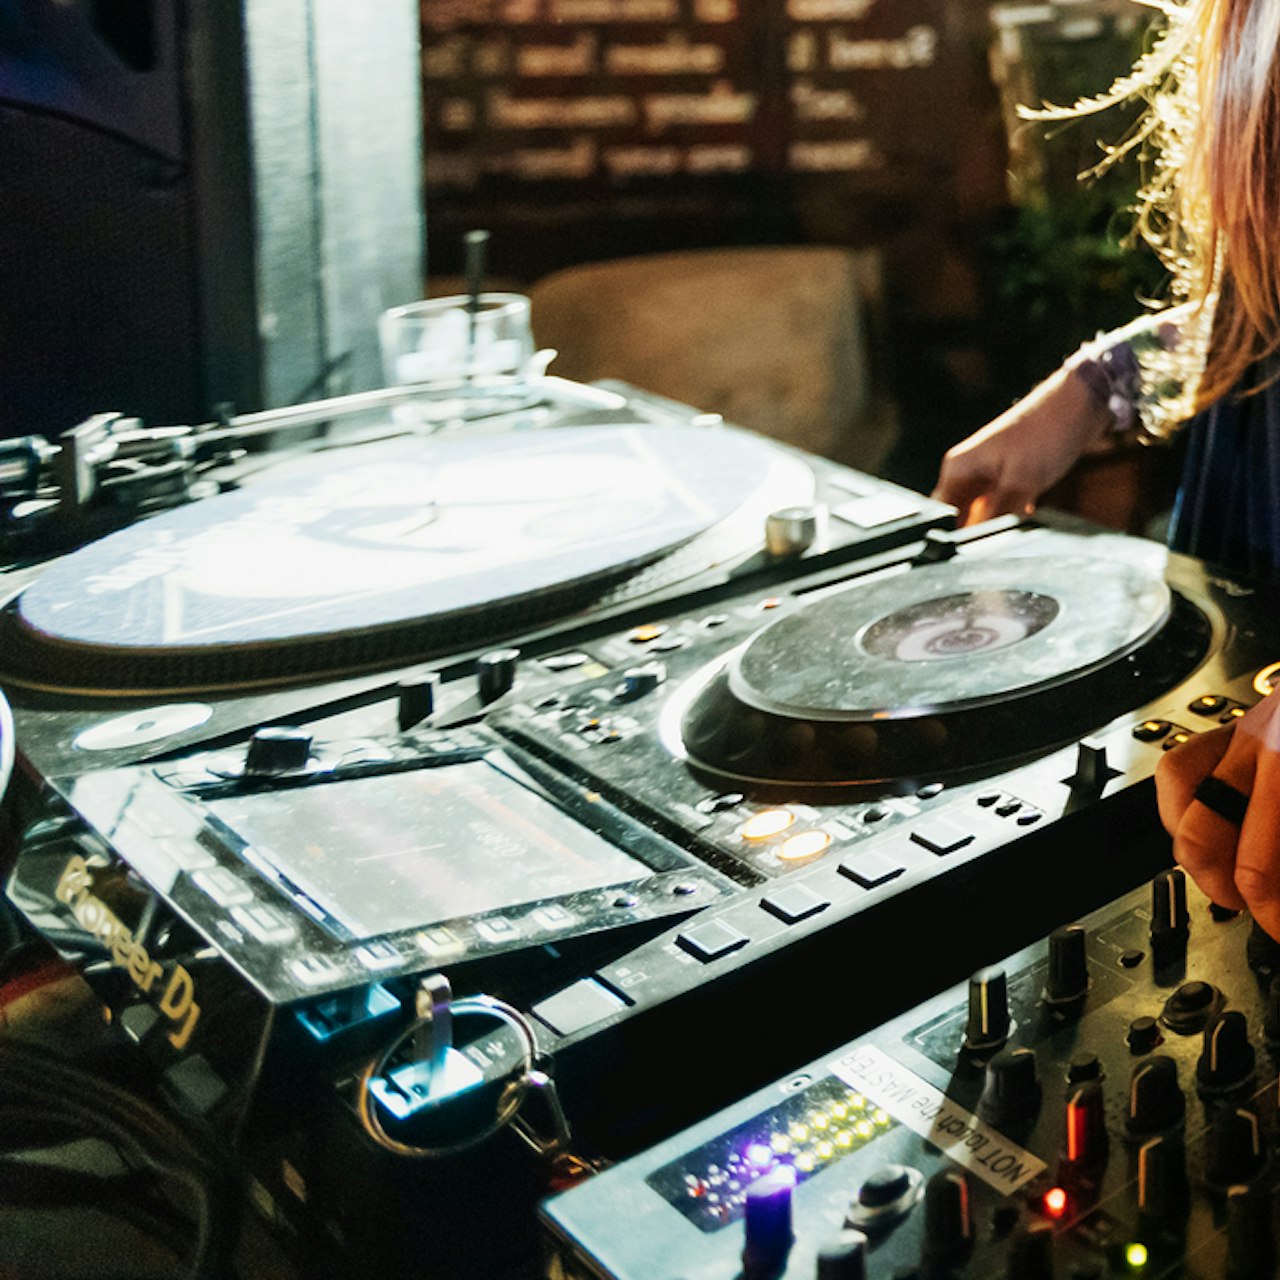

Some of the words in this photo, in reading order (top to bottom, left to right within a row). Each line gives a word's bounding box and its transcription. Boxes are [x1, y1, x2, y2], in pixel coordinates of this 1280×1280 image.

[160, 964, 200, 1049] DJ
[839, 1051, 918, 1104] MASTER
[936, 1114, 988, 1154] touch
[977, 1147, 1029, 1183] NOT
